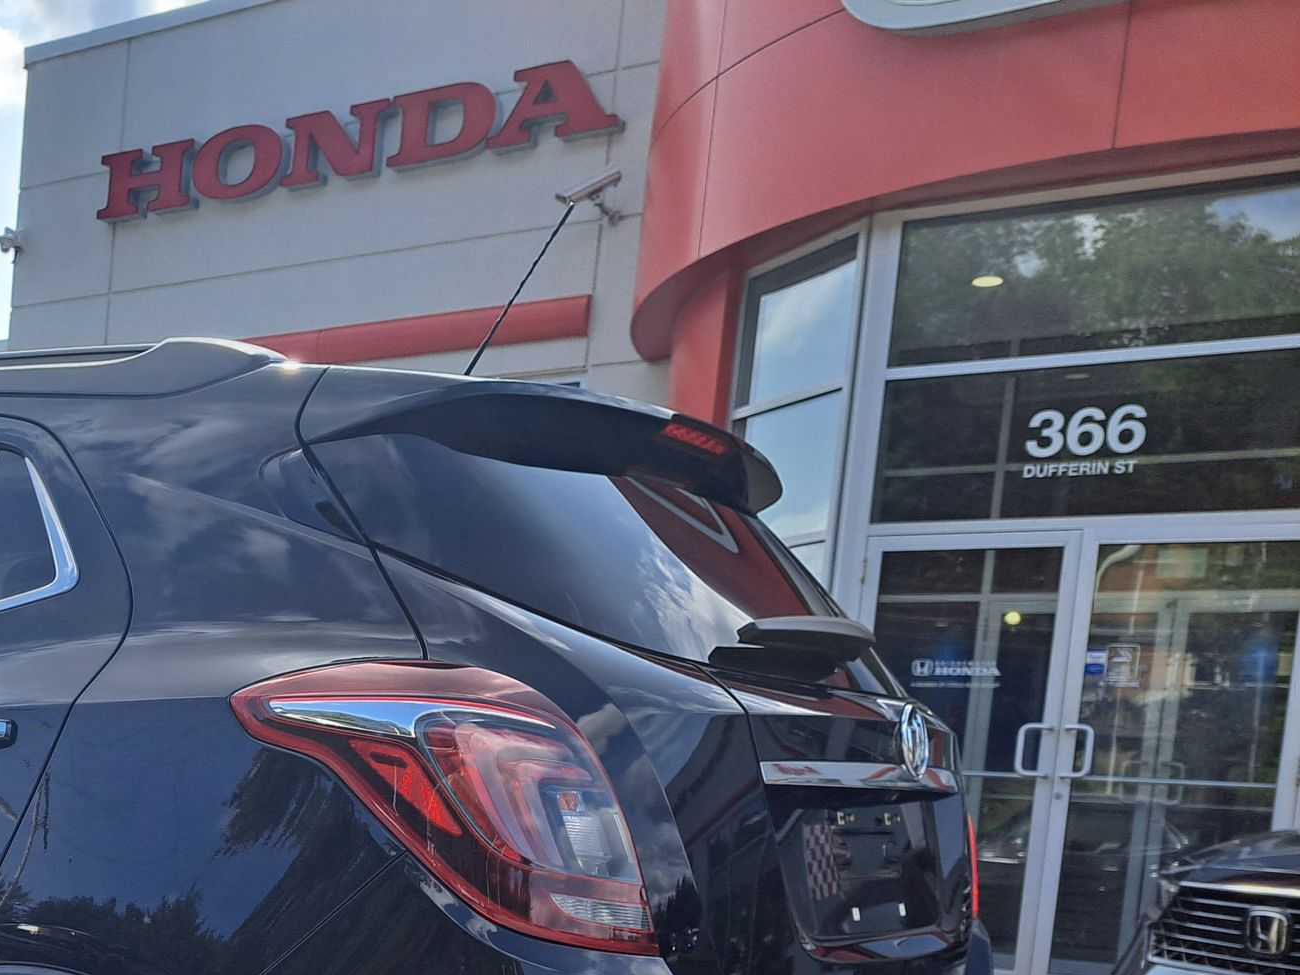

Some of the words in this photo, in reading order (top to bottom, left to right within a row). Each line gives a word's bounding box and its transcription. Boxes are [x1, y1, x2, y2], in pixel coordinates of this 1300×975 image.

[97, 59, 623, 223] HONDA
[1025, 403, 1148, 459] 366
[1022, 461, 1110, 479] DUFFERIN
[1113, 459, 1138, 475] ST
